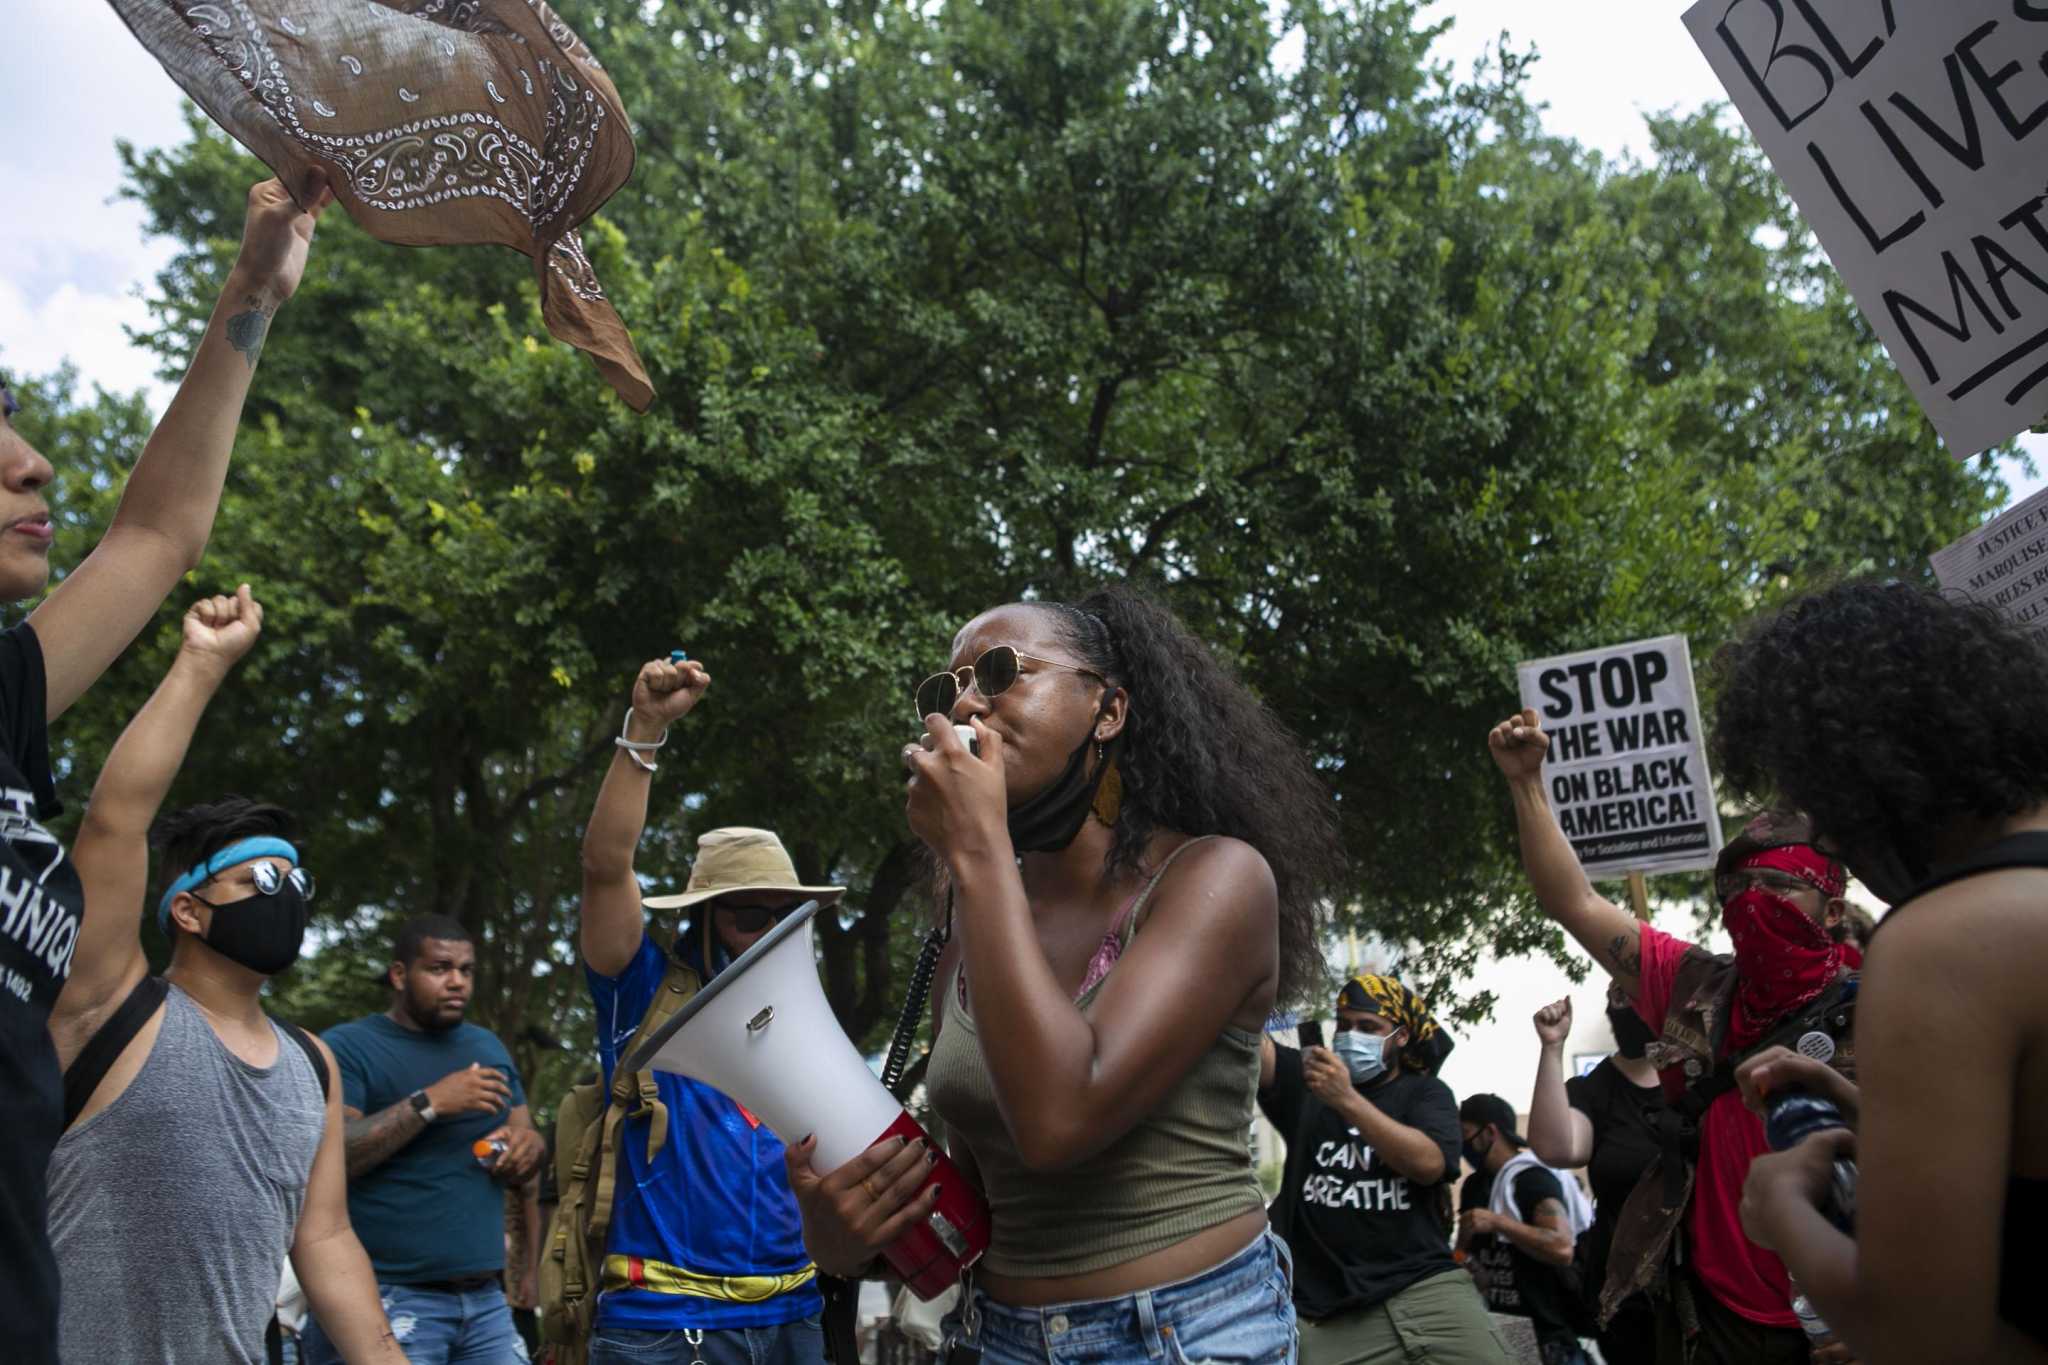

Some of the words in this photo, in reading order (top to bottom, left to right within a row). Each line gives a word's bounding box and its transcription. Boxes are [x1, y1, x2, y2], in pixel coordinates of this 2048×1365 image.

[1882, 187, 2048, 386] MAT
[1978, 513, 2038, 559] JUSTICE
[1968, 537, 2047, 590] MARQUISE
[1539, 650, 1668, 719] STOP
[1544, 722, 1602, 764] THE
[1605, 708, 1690, 753] WAR
[1552, 770, 1588, 804] ON
[1593, 756, 1692, 798] BLACK
[1560, 791, 1697, 838] AMERICA!
[1303, 1173, 1411, 1211] BREATHE
